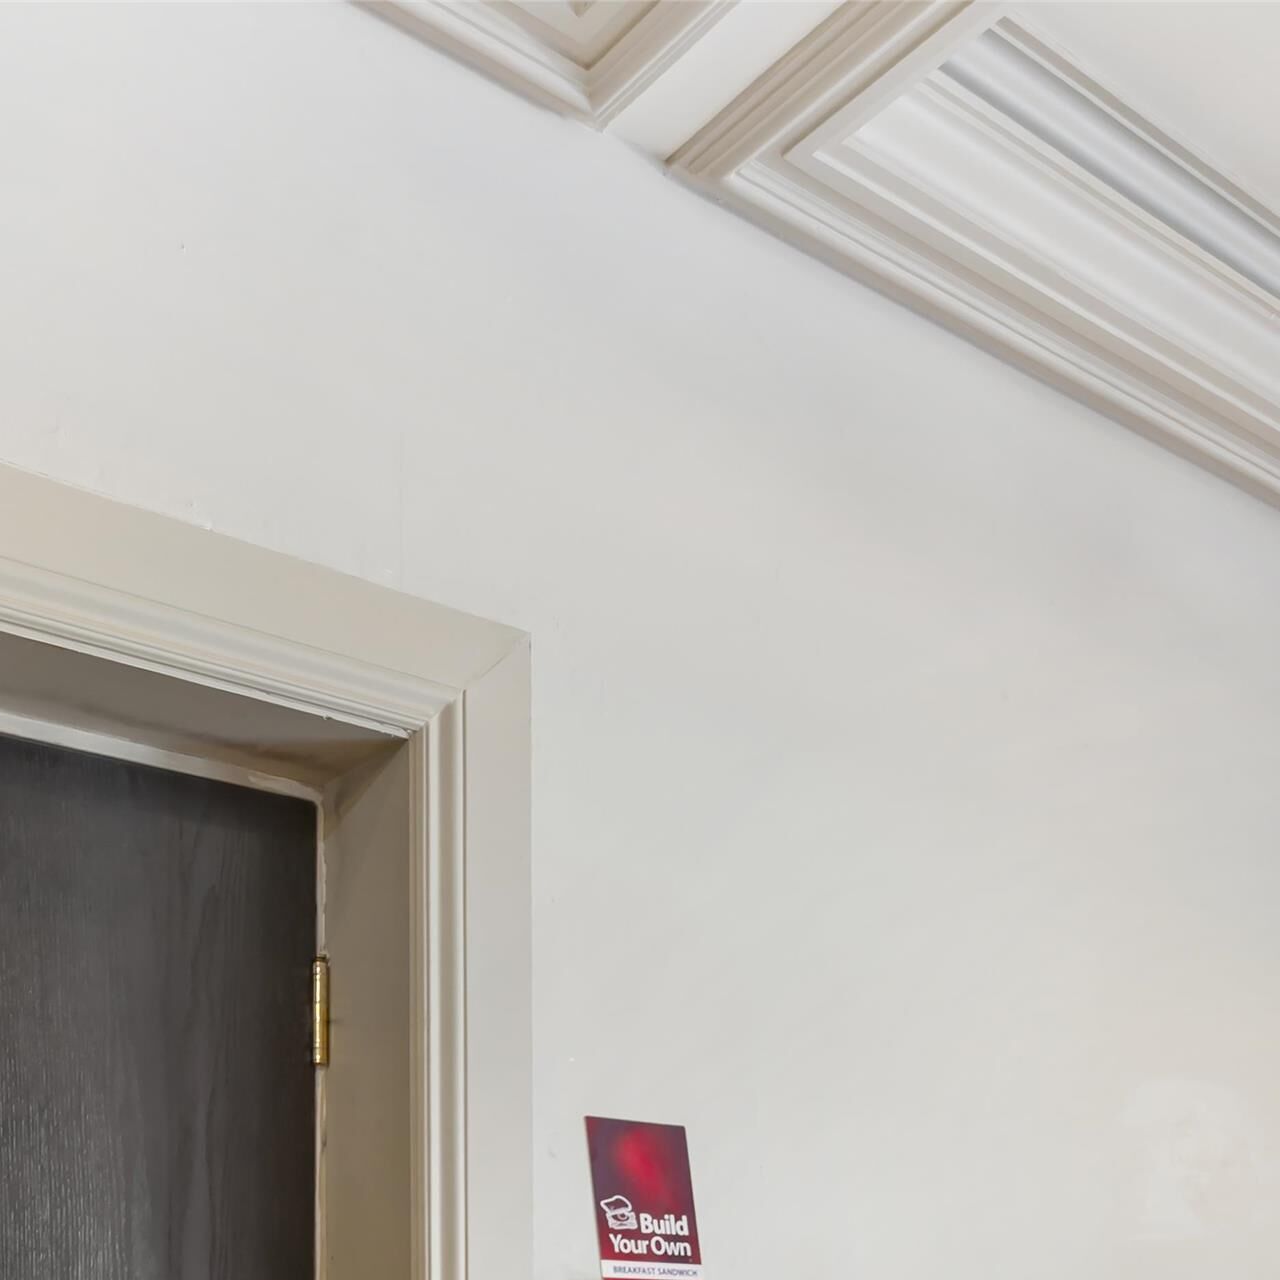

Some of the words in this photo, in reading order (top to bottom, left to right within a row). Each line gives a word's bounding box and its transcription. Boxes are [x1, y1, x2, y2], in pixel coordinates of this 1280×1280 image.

[639, 1213, 689, 1236] Build
[609, 1233, 649, 1254] Your
[650, 1236, 692, 1257] Own
[613, 1266, 656, 1275] BREAKFAST
[658, 1268, 698, 1277] SANDWICH
